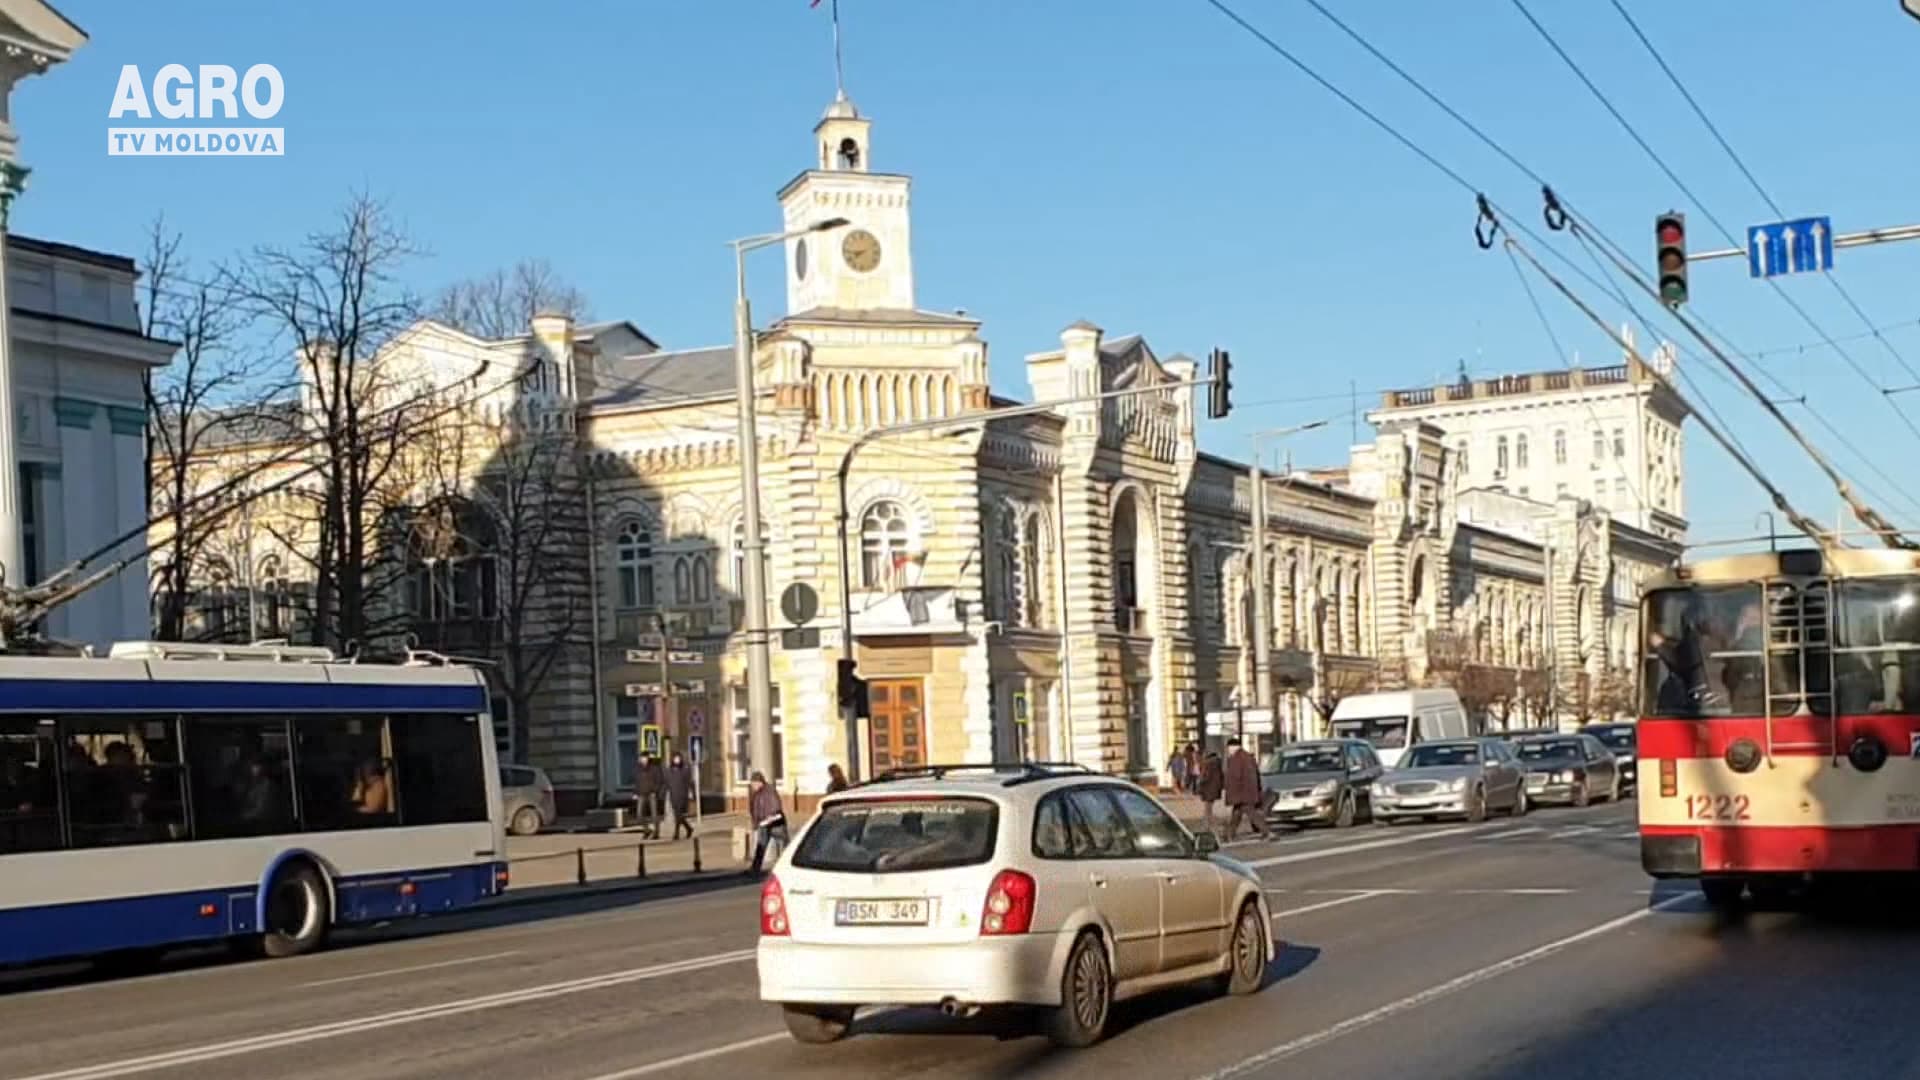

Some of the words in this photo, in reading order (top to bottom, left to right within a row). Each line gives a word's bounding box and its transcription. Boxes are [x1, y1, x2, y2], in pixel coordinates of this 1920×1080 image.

[1685, 795, 1751, 820] 1222
[849, 903, 878, 920] BSN
[890, 903, 919, 920] 349
